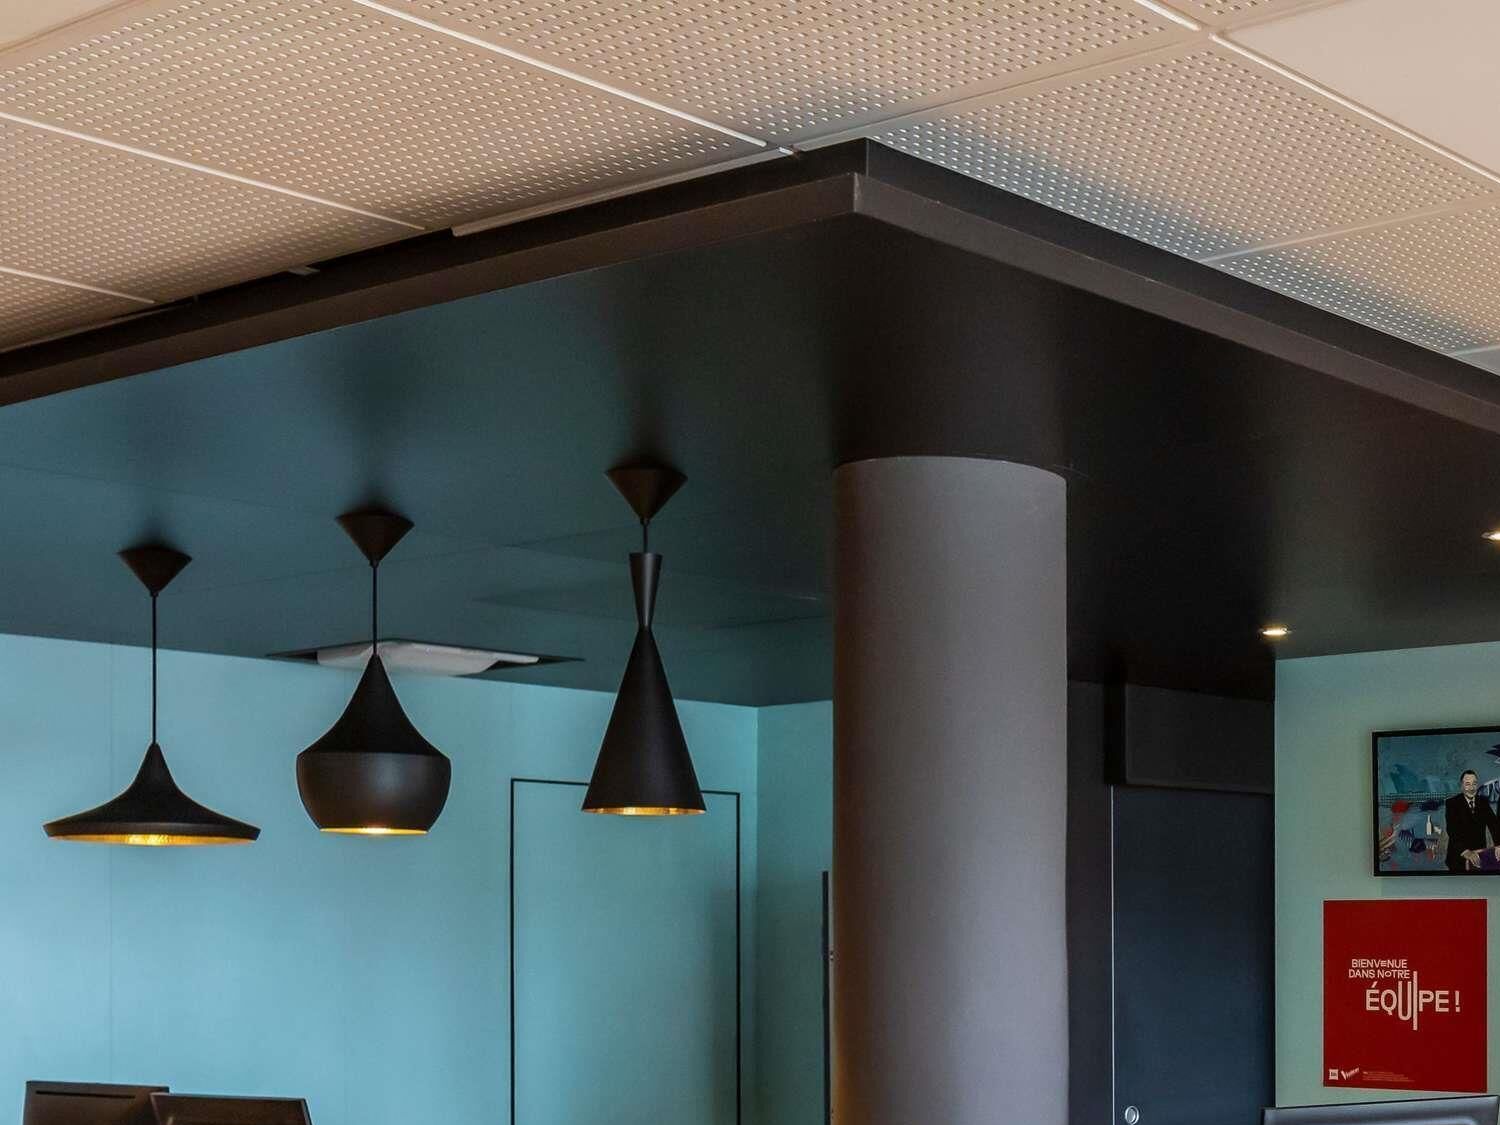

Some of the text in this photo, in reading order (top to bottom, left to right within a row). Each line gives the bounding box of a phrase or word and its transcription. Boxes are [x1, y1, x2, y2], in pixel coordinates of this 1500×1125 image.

[1351, 958, 1408, 968] BIENVENUE
[1348, 969, 1410, 979] DANS NOTRE
[1365, 970, 1450, 1031] ÉQUIPE
